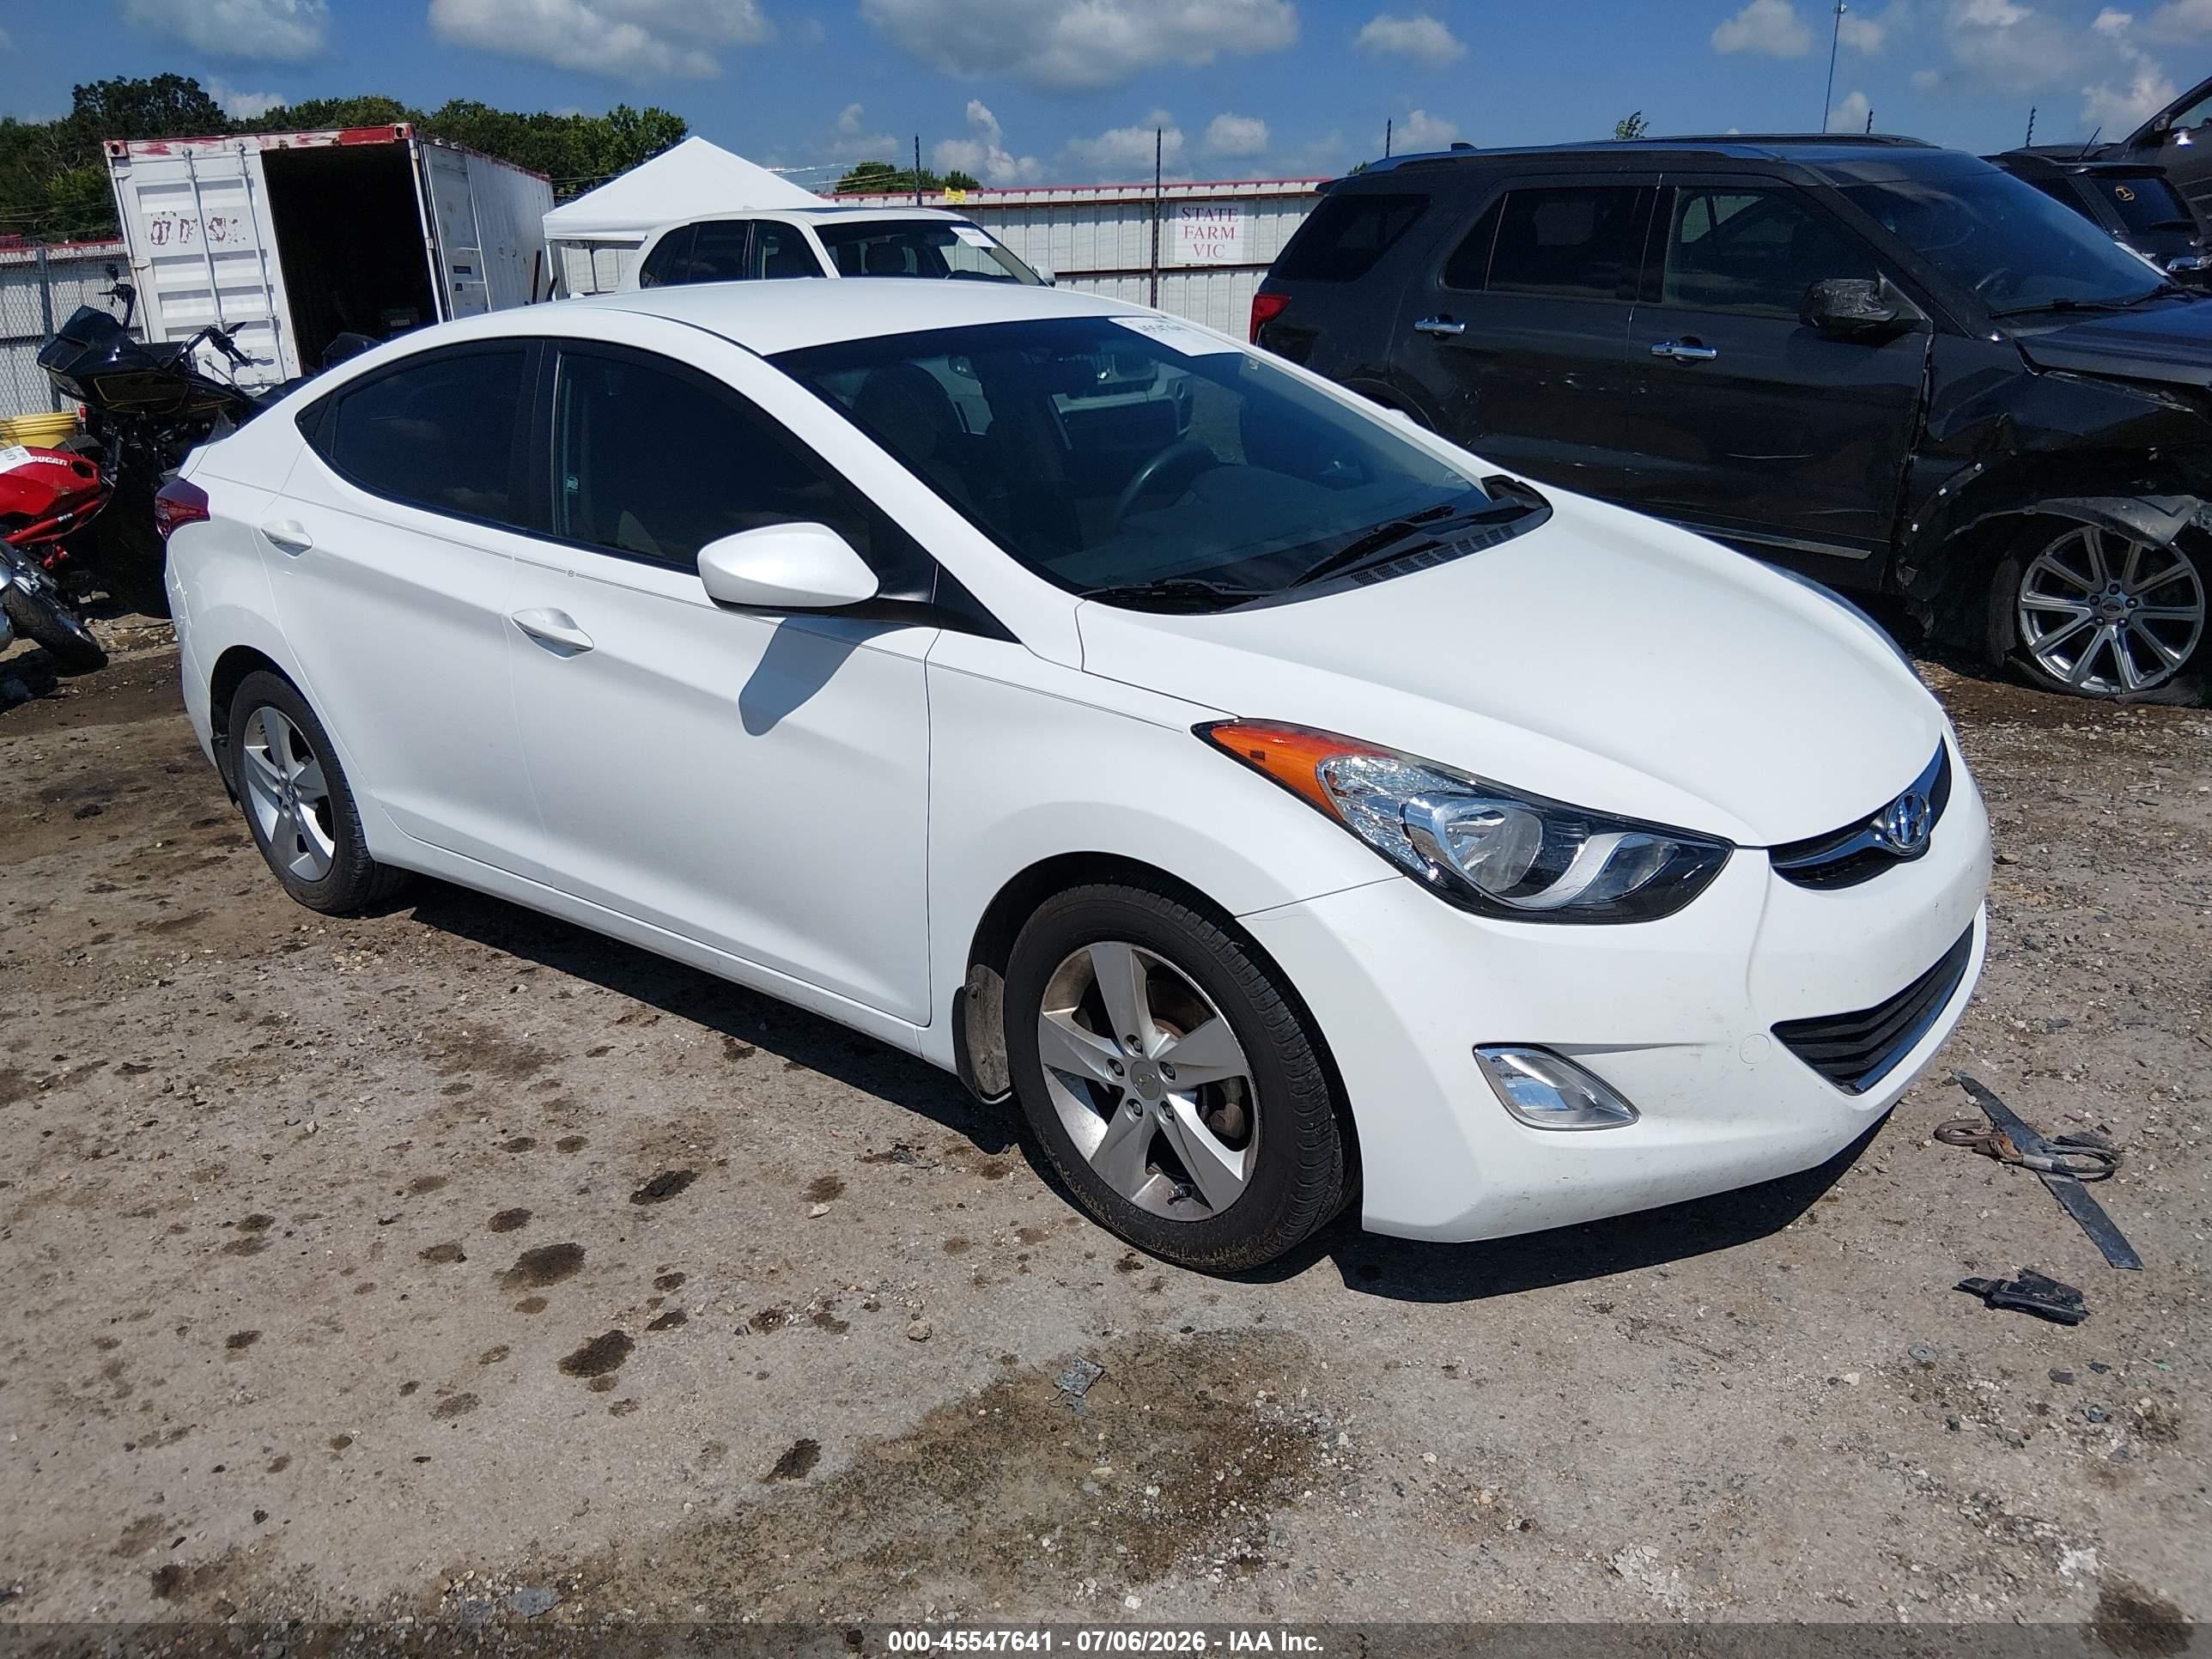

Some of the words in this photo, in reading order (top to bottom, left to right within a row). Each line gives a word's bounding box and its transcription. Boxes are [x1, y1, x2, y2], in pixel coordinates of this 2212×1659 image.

[1181, 206, 1239, 222] STATE
[1184, 225, 1236, 240] FARM
[1193, 243, 1225, 258] VIC
[31, 455, 69, 466] DUCATI
